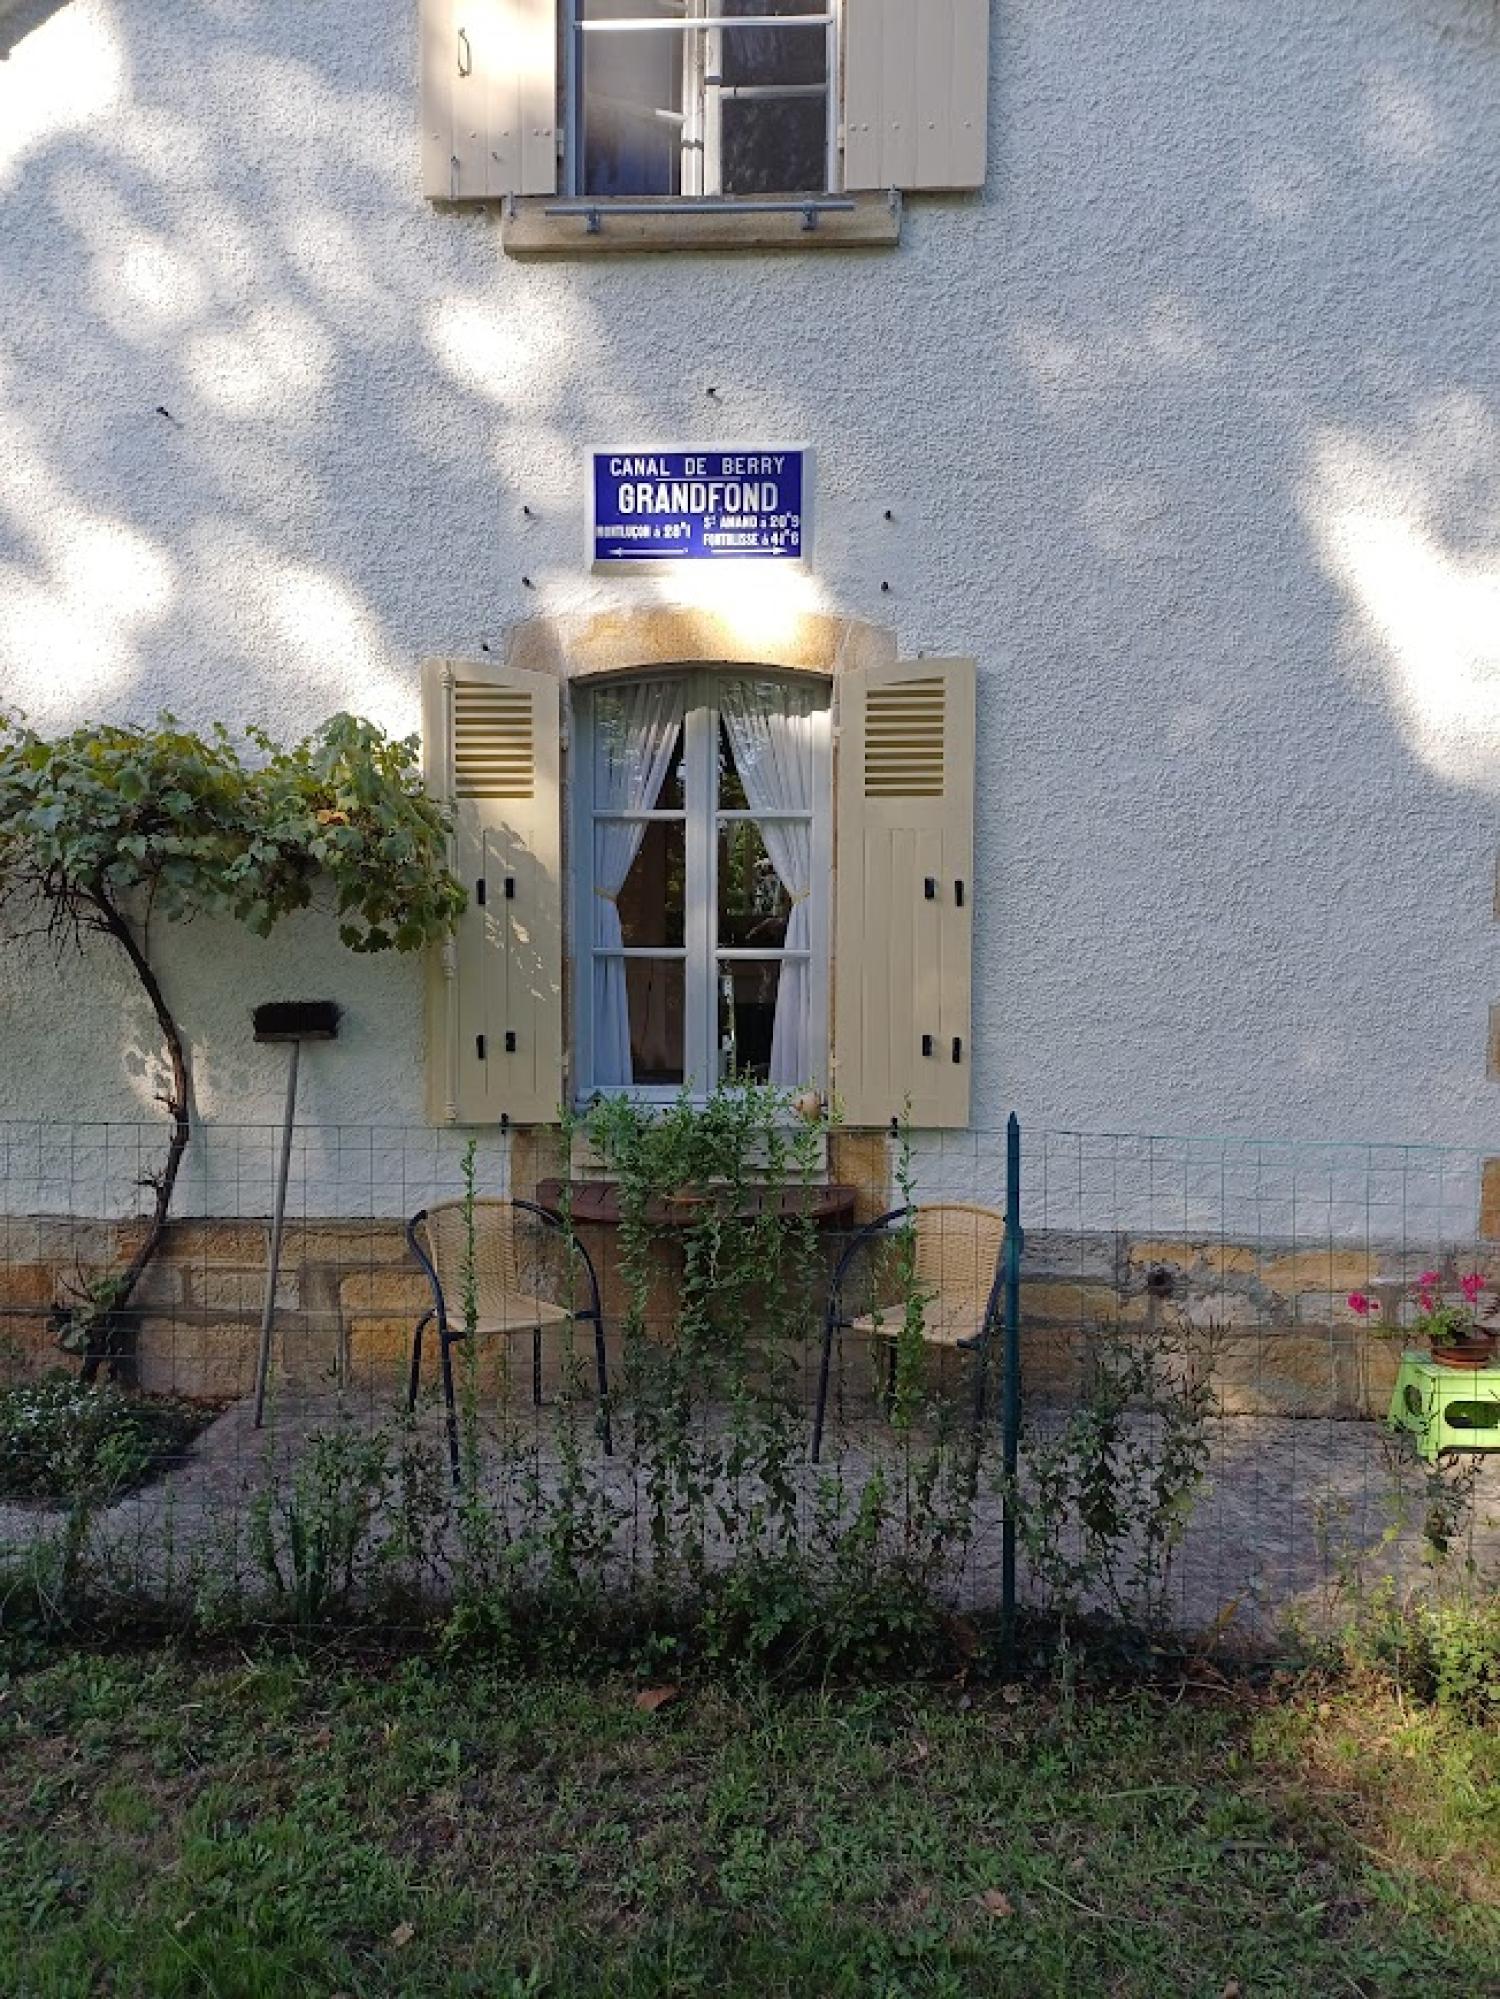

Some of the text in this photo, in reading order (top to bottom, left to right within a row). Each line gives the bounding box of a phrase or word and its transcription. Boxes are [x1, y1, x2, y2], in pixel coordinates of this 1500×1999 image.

[610, 456, 785, 477] CANAL DE BERRY
[618, 482, 778, 514] GRANDFOND
